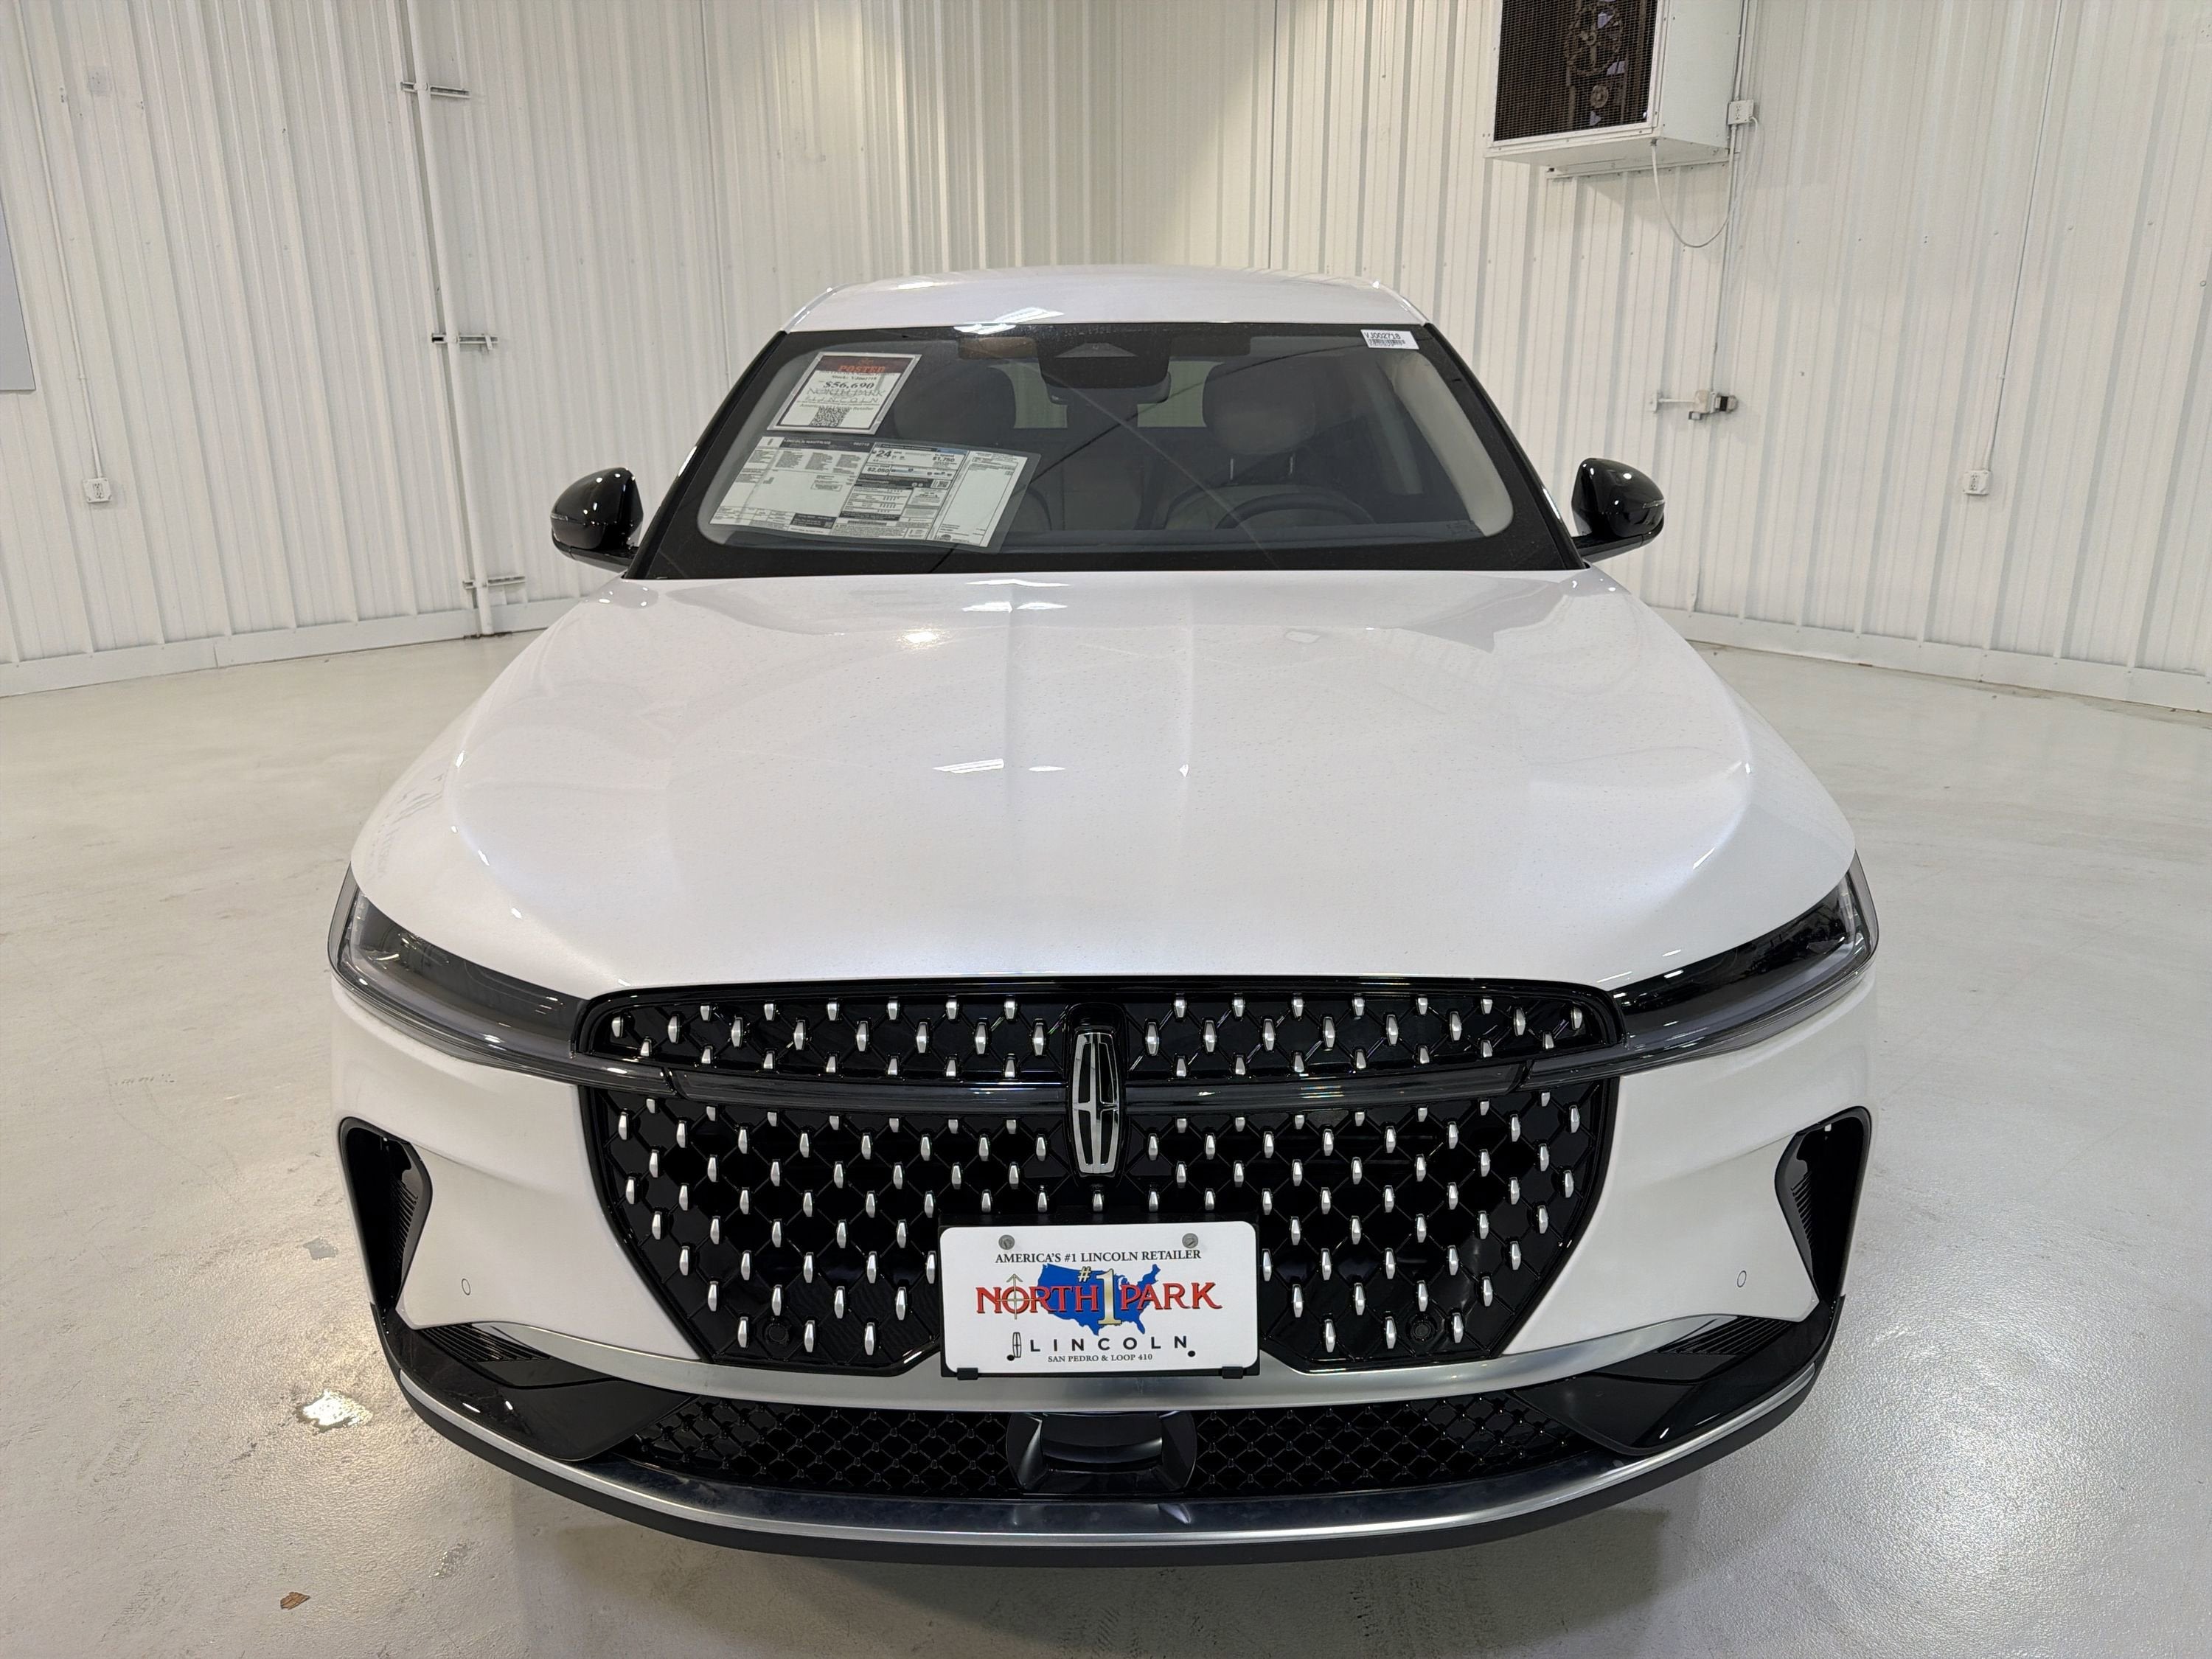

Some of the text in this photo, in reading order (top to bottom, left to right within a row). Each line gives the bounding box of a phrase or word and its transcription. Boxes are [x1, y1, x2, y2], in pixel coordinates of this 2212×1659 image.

[838, 365, 886, 374] POSTED
[823, 381, 874, 389] $56,690
[875, 450, 891, 458] 24
[995, 1249, 1202, 1264] AMERICA'S #1 LINCOLN RETAILER
[975, 1281, 1223, 1315] NORTH PARK
[1030, 1335, 1188, 1353] LINCOLN
[1068, 1354, 1099, 1363] PEDRO
[1101, 1354, 1108, 1362] &
[1110, 1354, 1136, 1362] LOOP
[1138, 1353, 1153, 1361] 410
